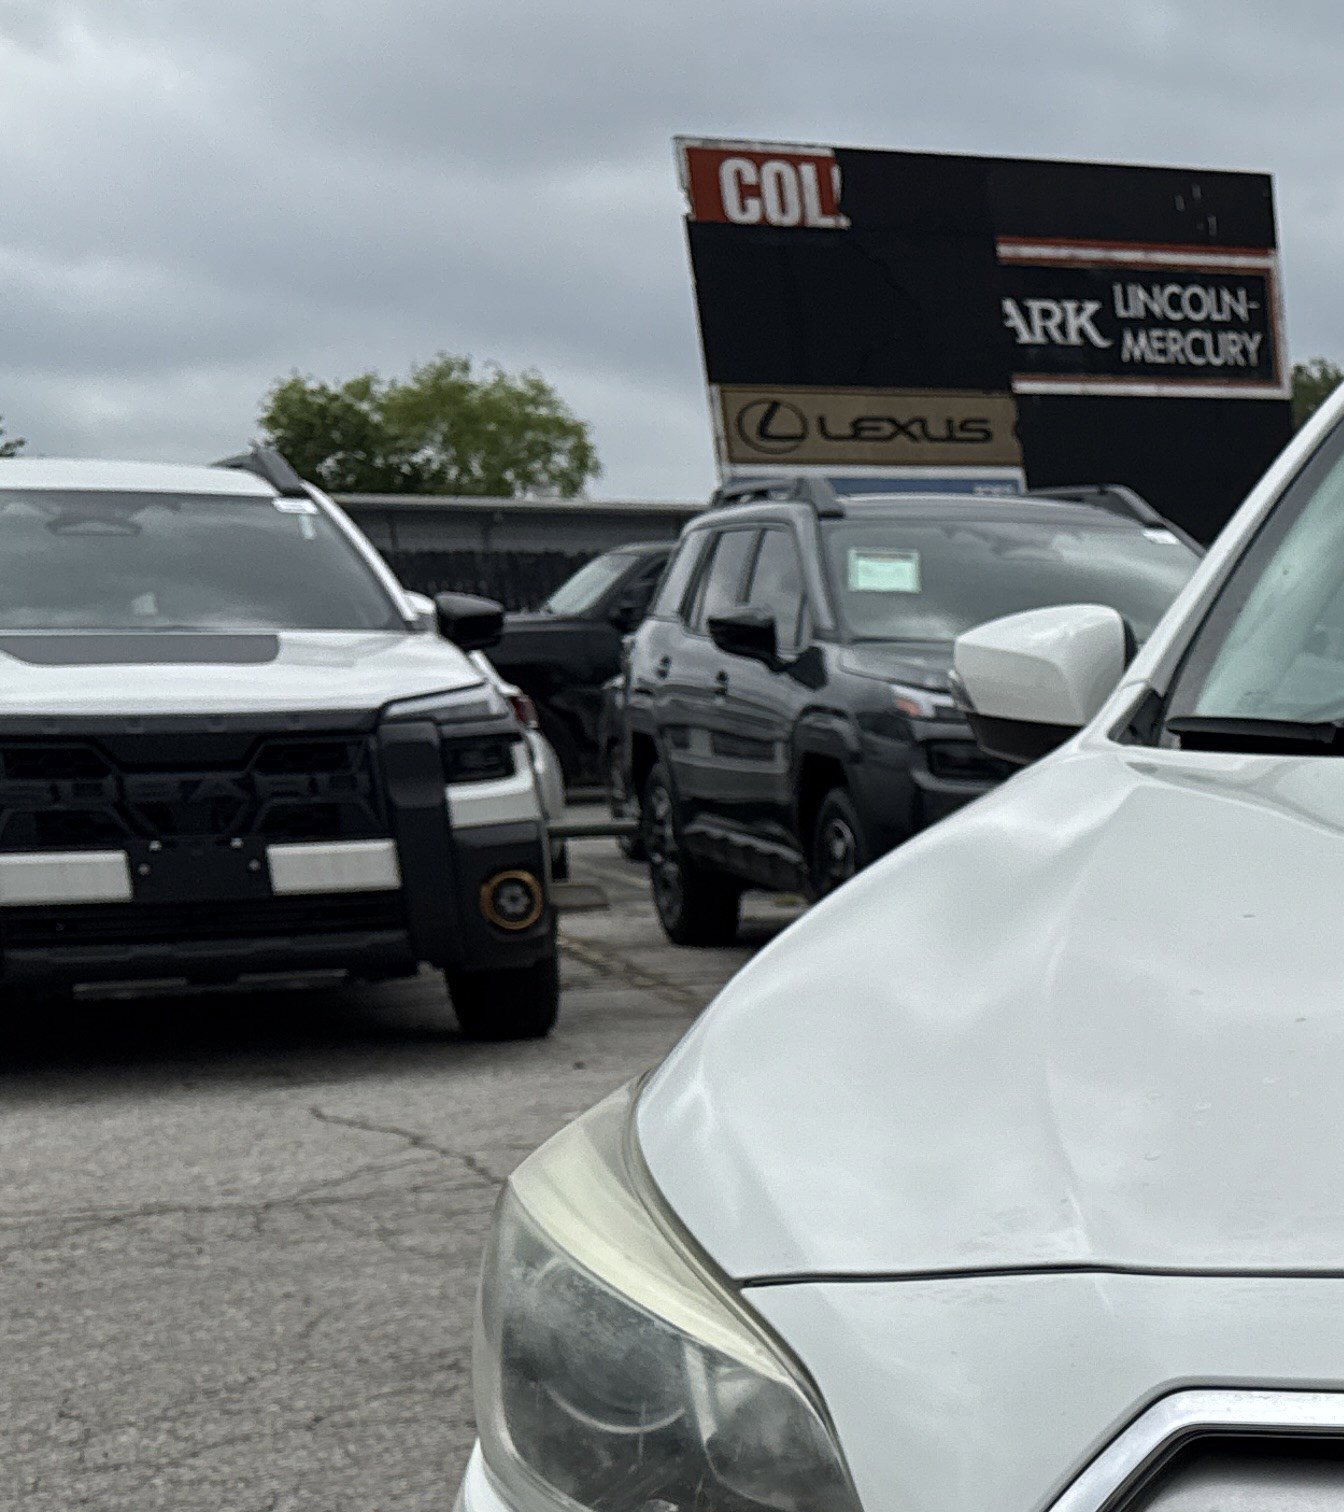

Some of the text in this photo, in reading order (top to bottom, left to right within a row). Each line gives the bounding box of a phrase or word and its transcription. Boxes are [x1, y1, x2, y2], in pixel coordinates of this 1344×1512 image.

[718, 156, 851, 229] COL
[1112, 281, 1261, 322] LINCOLN-
[1121, 326, 1263, 367] MERCURY
[816, 414, 993, 443] LEXUS
